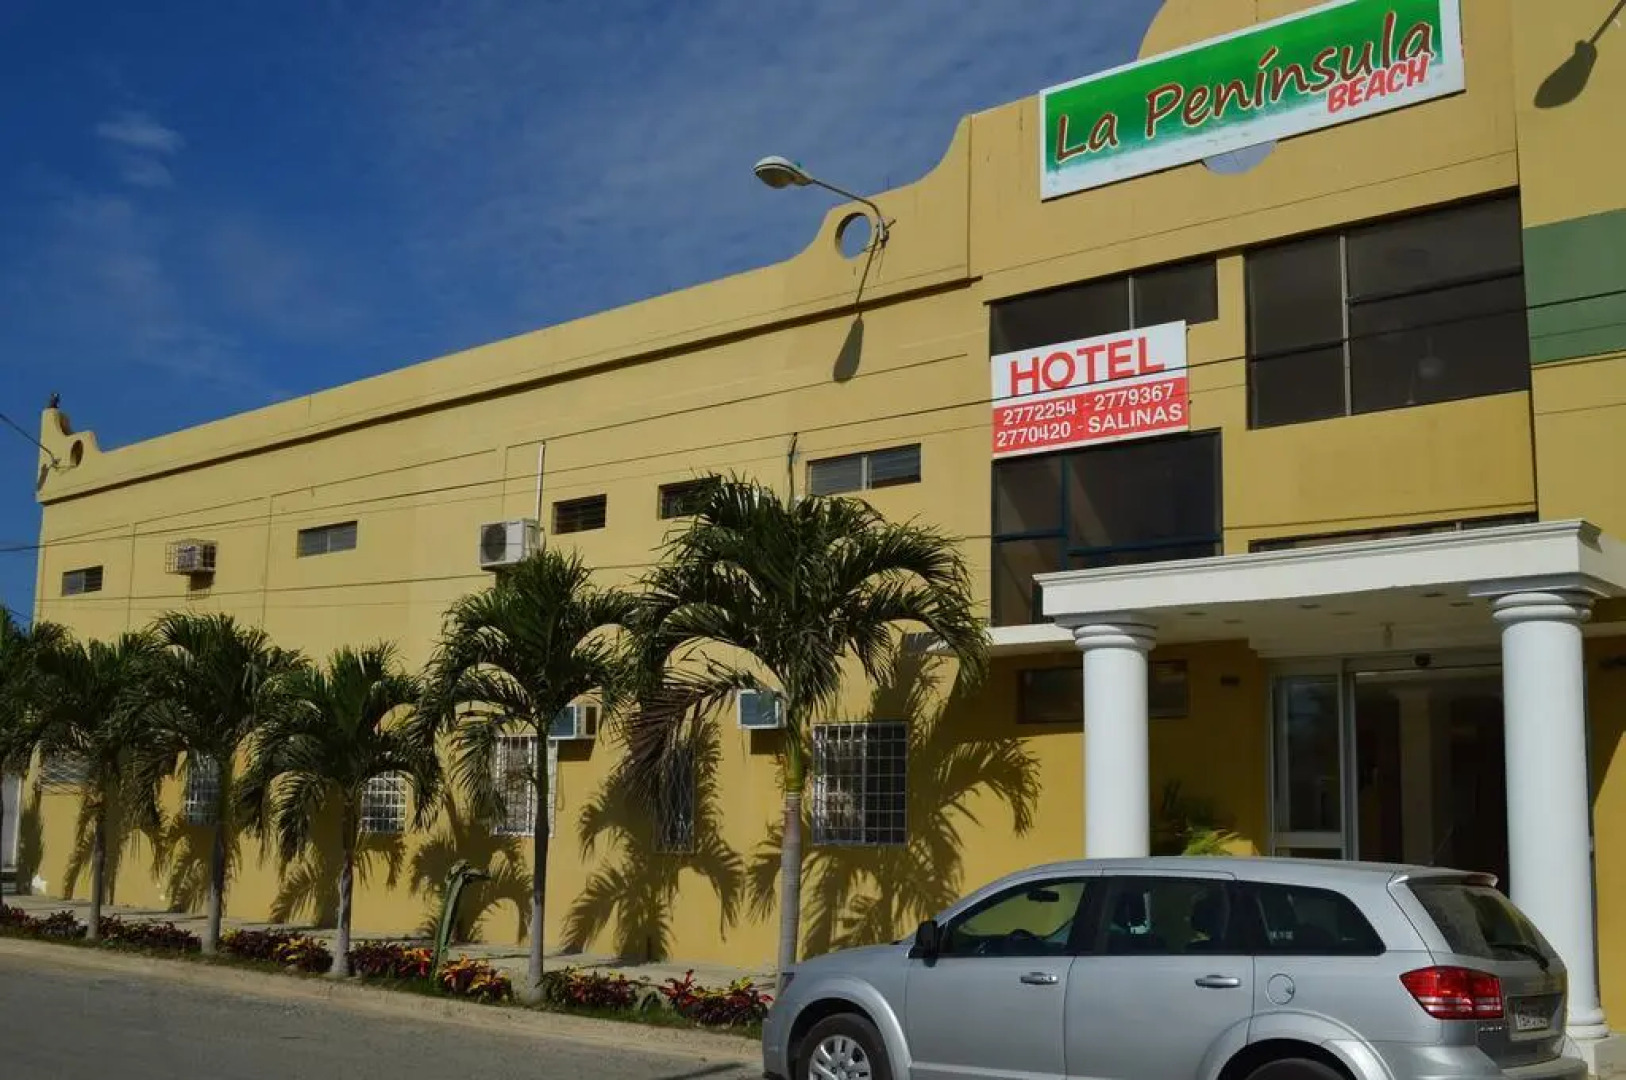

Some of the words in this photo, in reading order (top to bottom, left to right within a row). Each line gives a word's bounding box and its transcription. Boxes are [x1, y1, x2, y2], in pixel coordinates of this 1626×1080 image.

[1056, 113, 1118, 163] La
[1144, 11, 1433, 139] Península
[1327, 54, 1429, 113] BEACH
[1010, 337, 1164, 396] HOTEL
[997, 421, 1071, 447] 2770420
[1088, 403, 1182, 433] SALINAS
[1003, 400, 1077, 425] 2772254
[1094, 382, 1174, 411] 2779367
